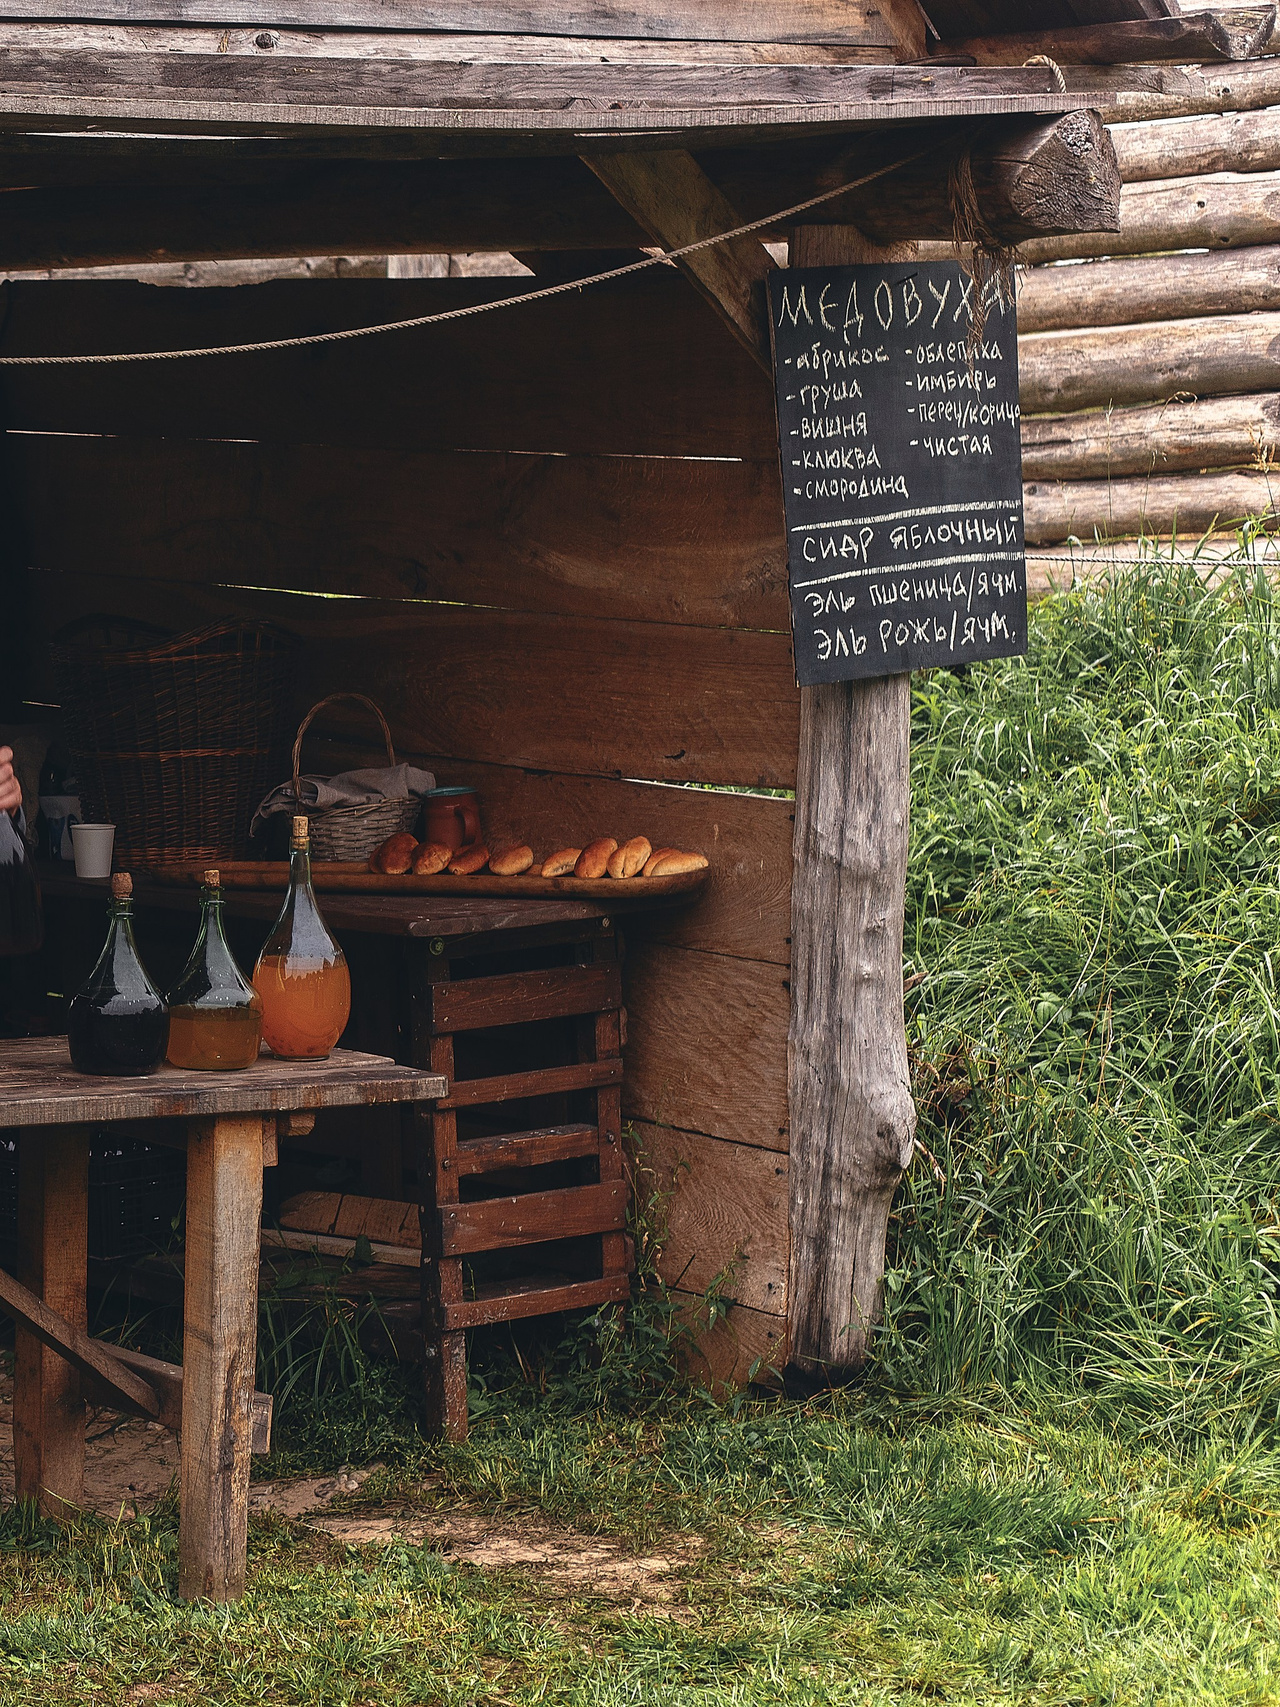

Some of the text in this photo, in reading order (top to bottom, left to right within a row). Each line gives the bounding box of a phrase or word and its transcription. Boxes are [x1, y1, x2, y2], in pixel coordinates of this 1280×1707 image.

[778, 268, 1006, 346] МЕДОВУХА
[802, 515, 1019, 563] СИДР ЯБЛОЧНЫЙ
